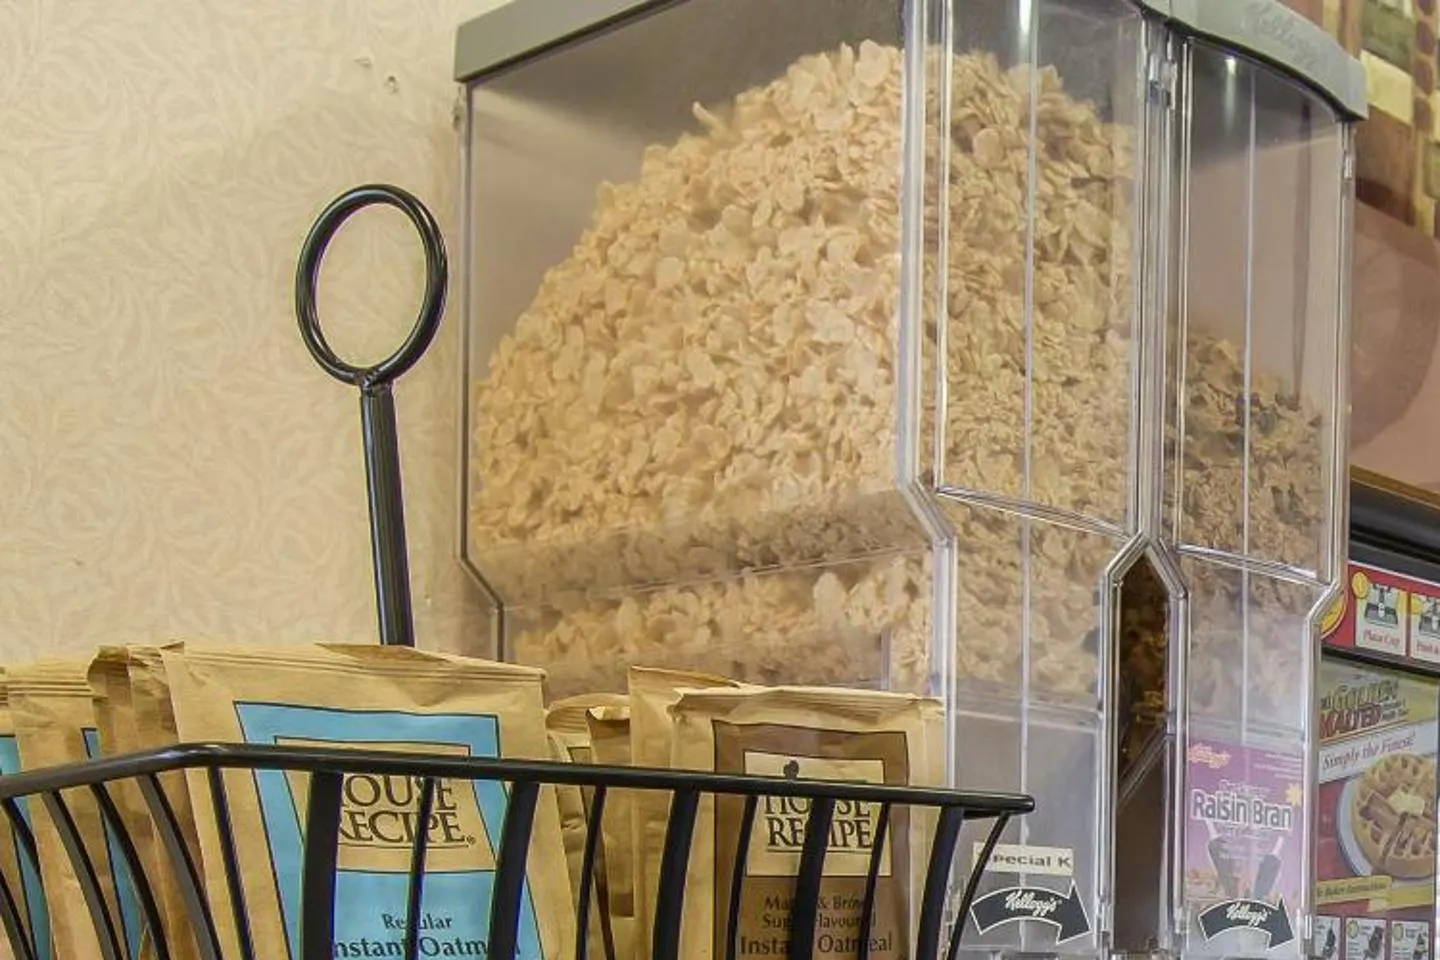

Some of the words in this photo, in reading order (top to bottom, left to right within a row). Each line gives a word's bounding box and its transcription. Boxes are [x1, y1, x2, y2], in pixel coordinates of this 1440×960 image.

[342, 775, 457, 811] OUE
[764, 796, 871, 818] HOSE
[340, 809, 465, 843] ECIPE
[1191, 788, 1248, 824] Raisin
[1252, 799, 1294, 832] Bran
[765, 816, 873, 848] REIPE
[992, 853, 1051, 868] pecial
[1058, 856, 1070, 868] K
[382, 912, 453, 932] Reular
